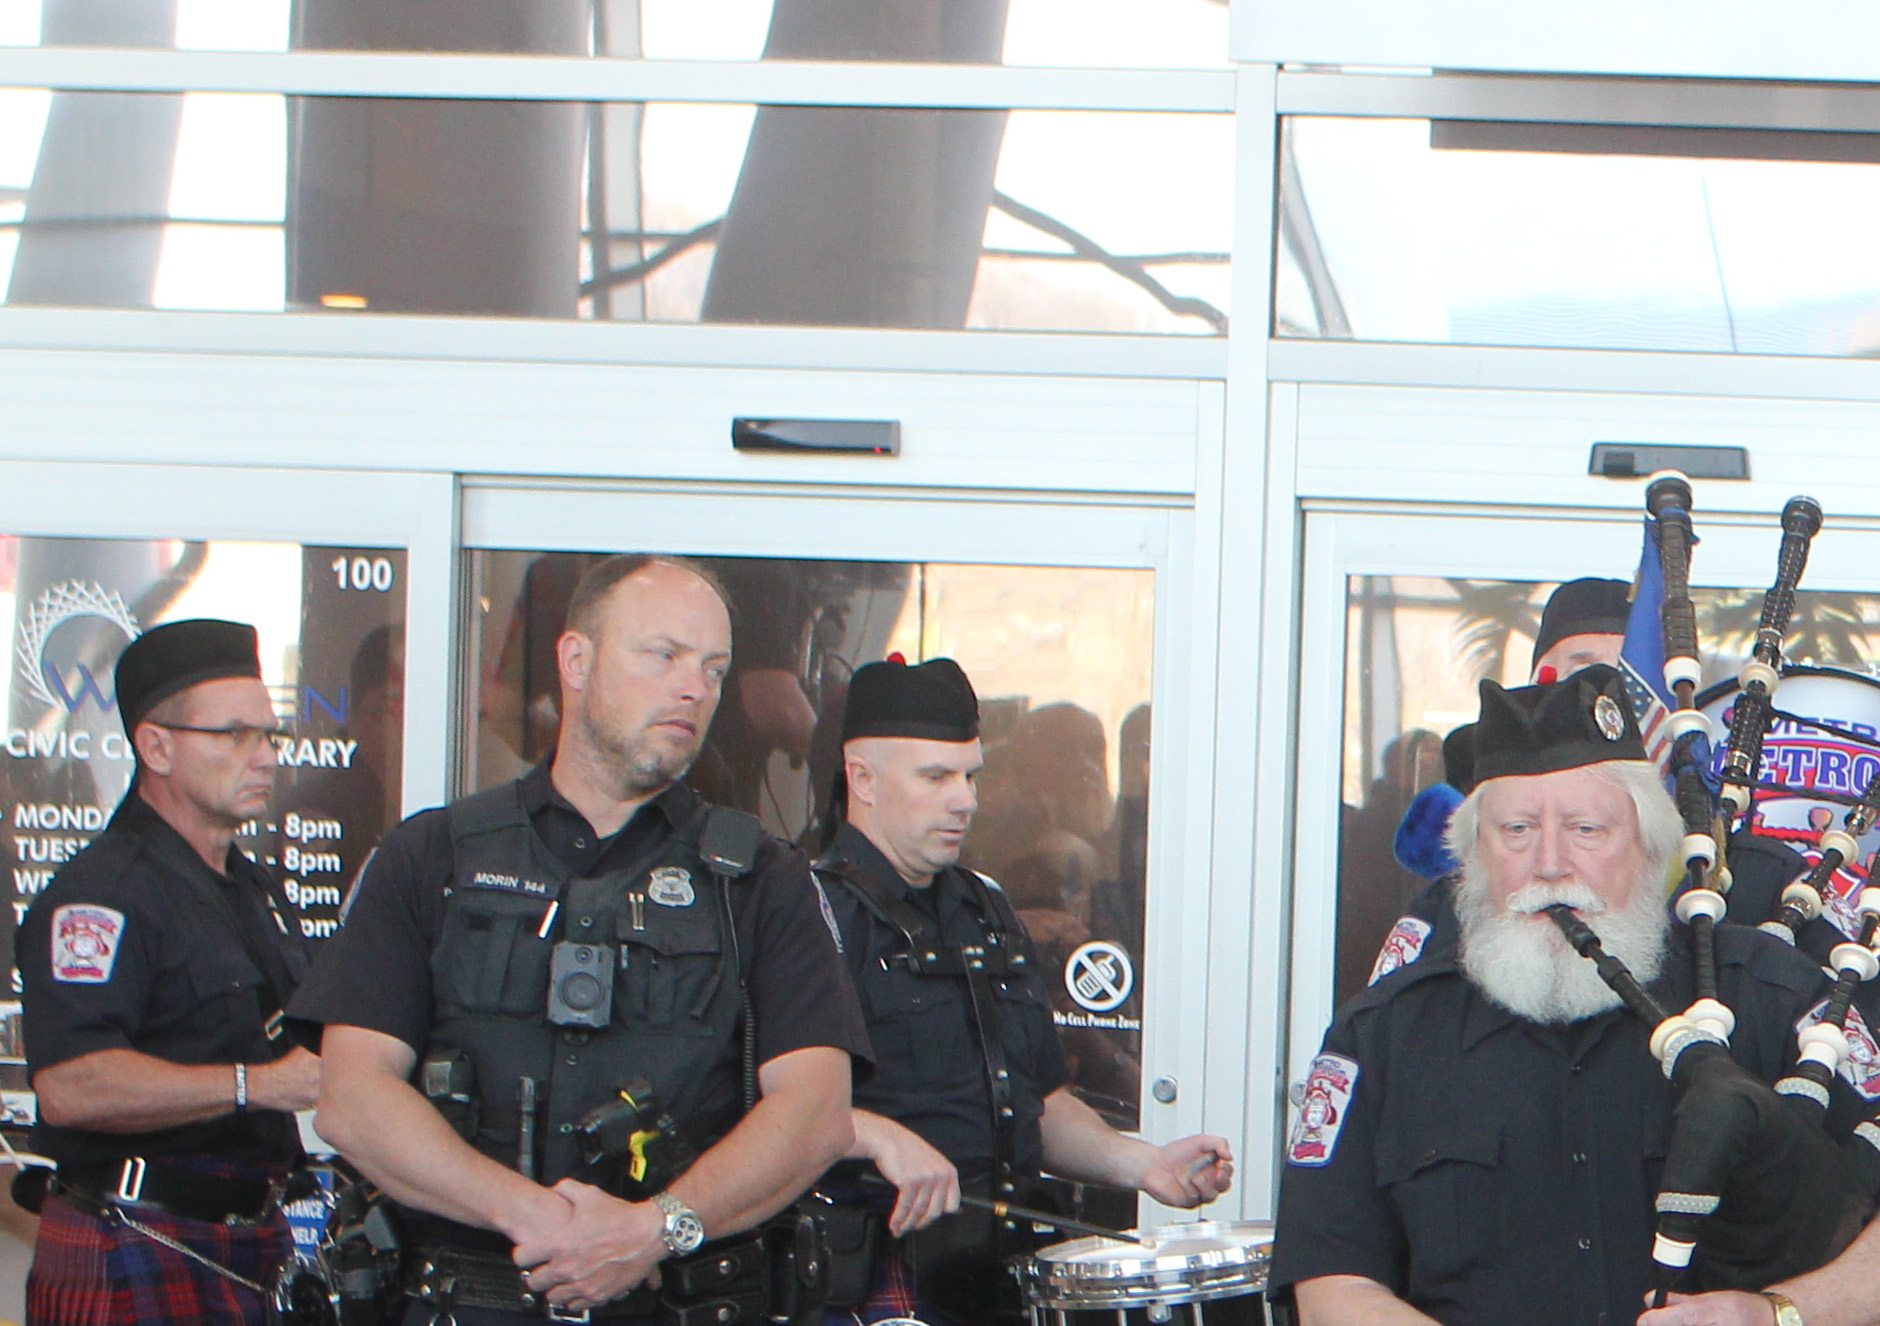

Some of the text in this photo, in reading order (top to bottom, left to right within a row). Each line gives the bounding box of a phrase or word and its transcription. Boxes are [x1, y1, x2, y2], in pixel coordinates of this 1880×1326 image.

[330, 555, 393, 592] 100
[6, 730, 91, 759] CIVIC
[283, 811, 342, 844] 8pm
[282, 845, 341, 877] 8pm
[282, 877, 340, 910] 8pm
[473, 871, 519, 889] MORIN
